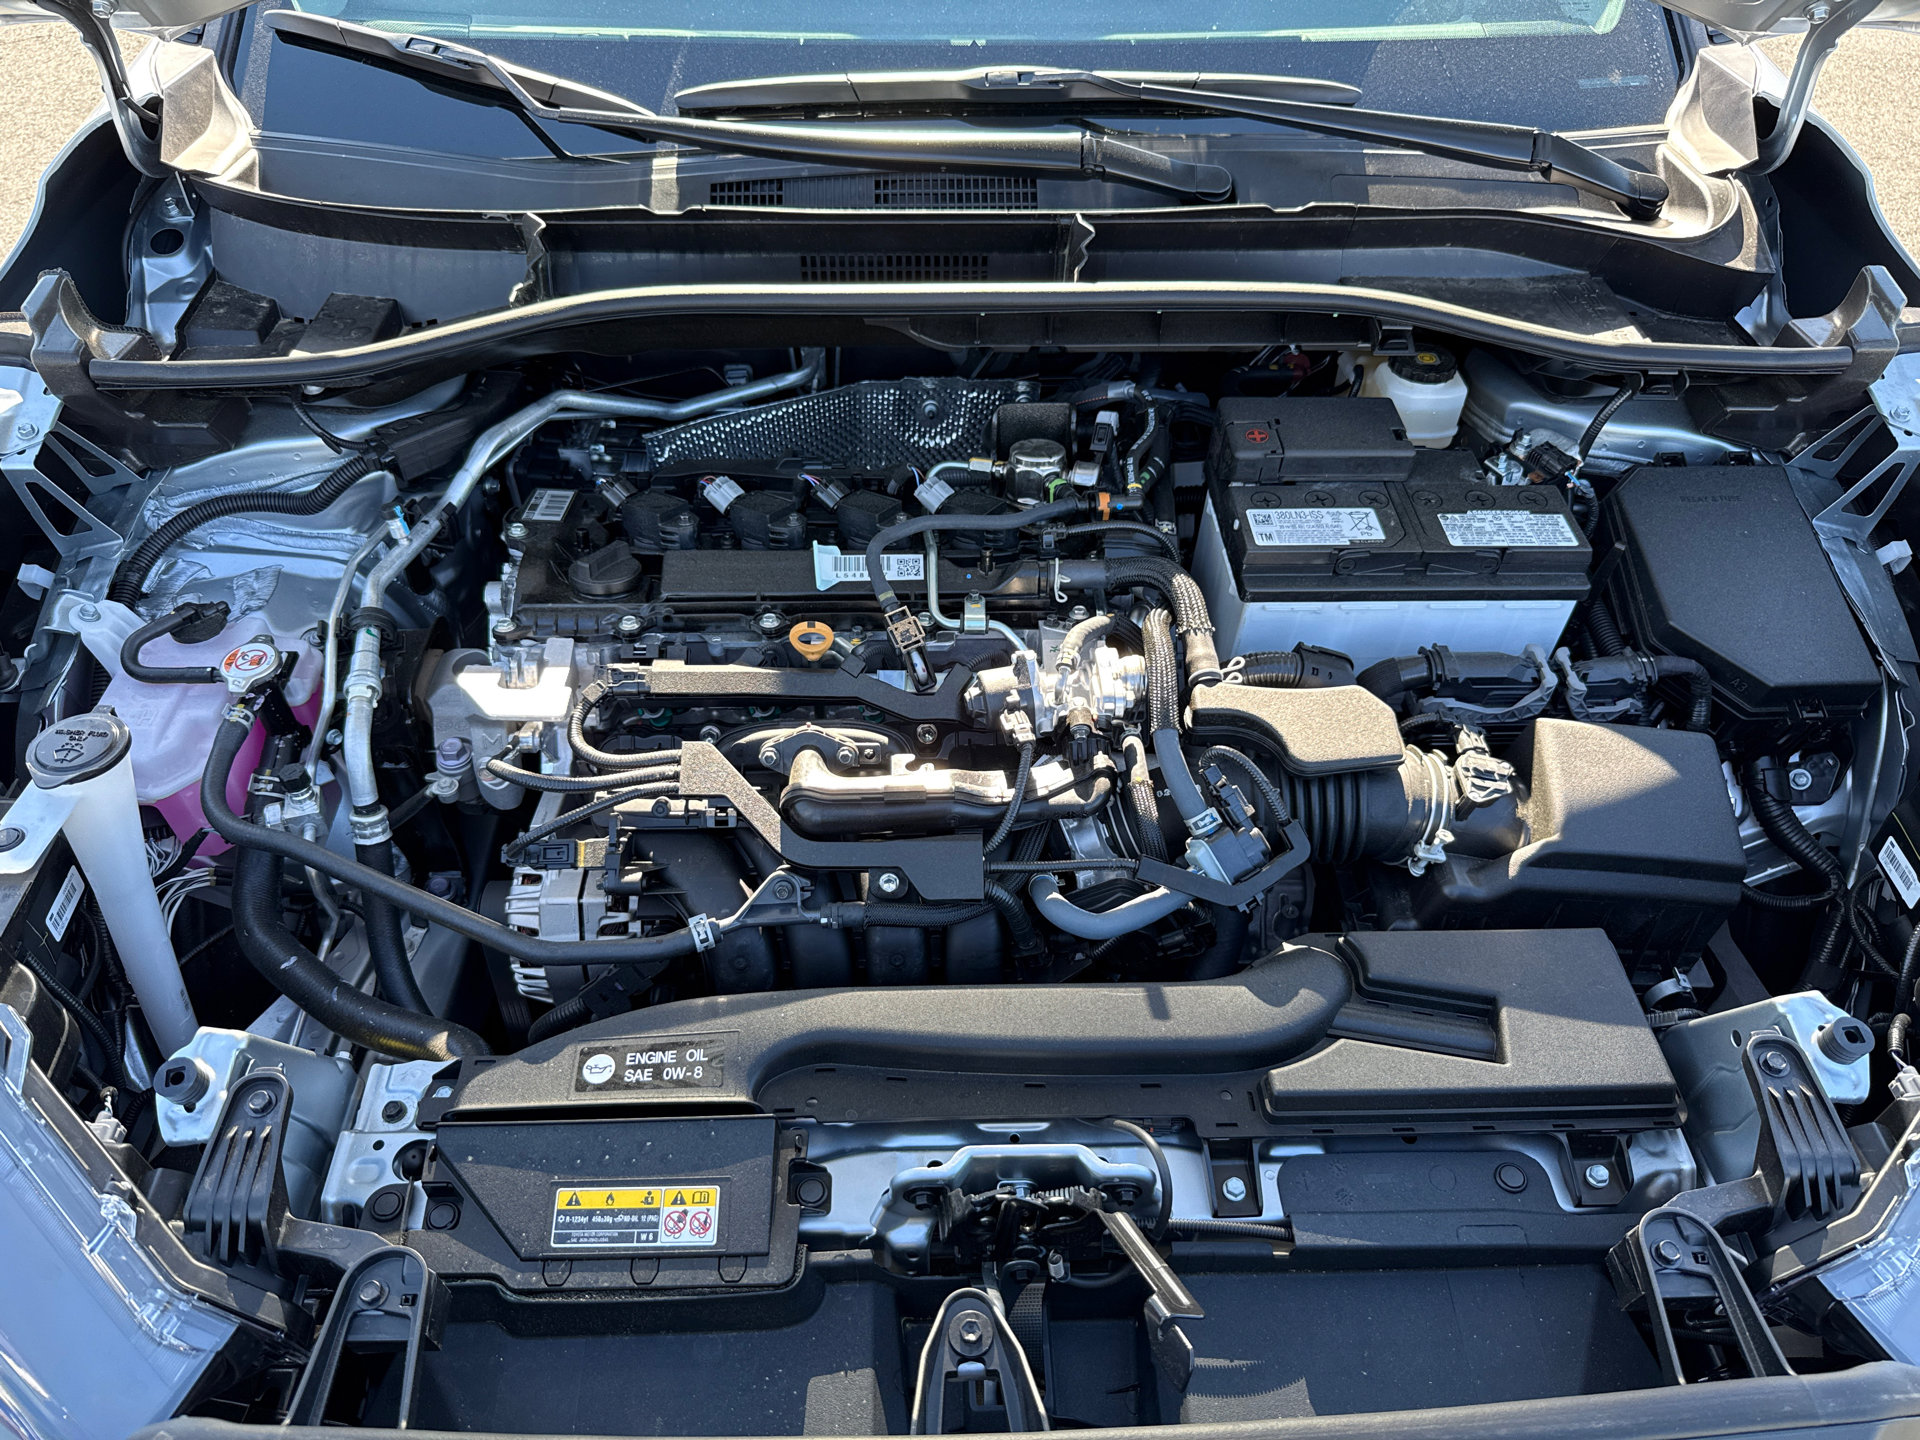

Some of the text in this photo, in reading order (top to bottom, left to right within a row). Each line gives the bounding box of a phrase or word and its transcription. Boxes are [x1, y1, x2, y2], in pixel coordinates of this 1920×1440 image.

[1259, 532, 1274, 542] TM
[625, 1048, 709, 1066] ENGINE OIL
[623, 1065, 703, 1083] SAE 0W-8
